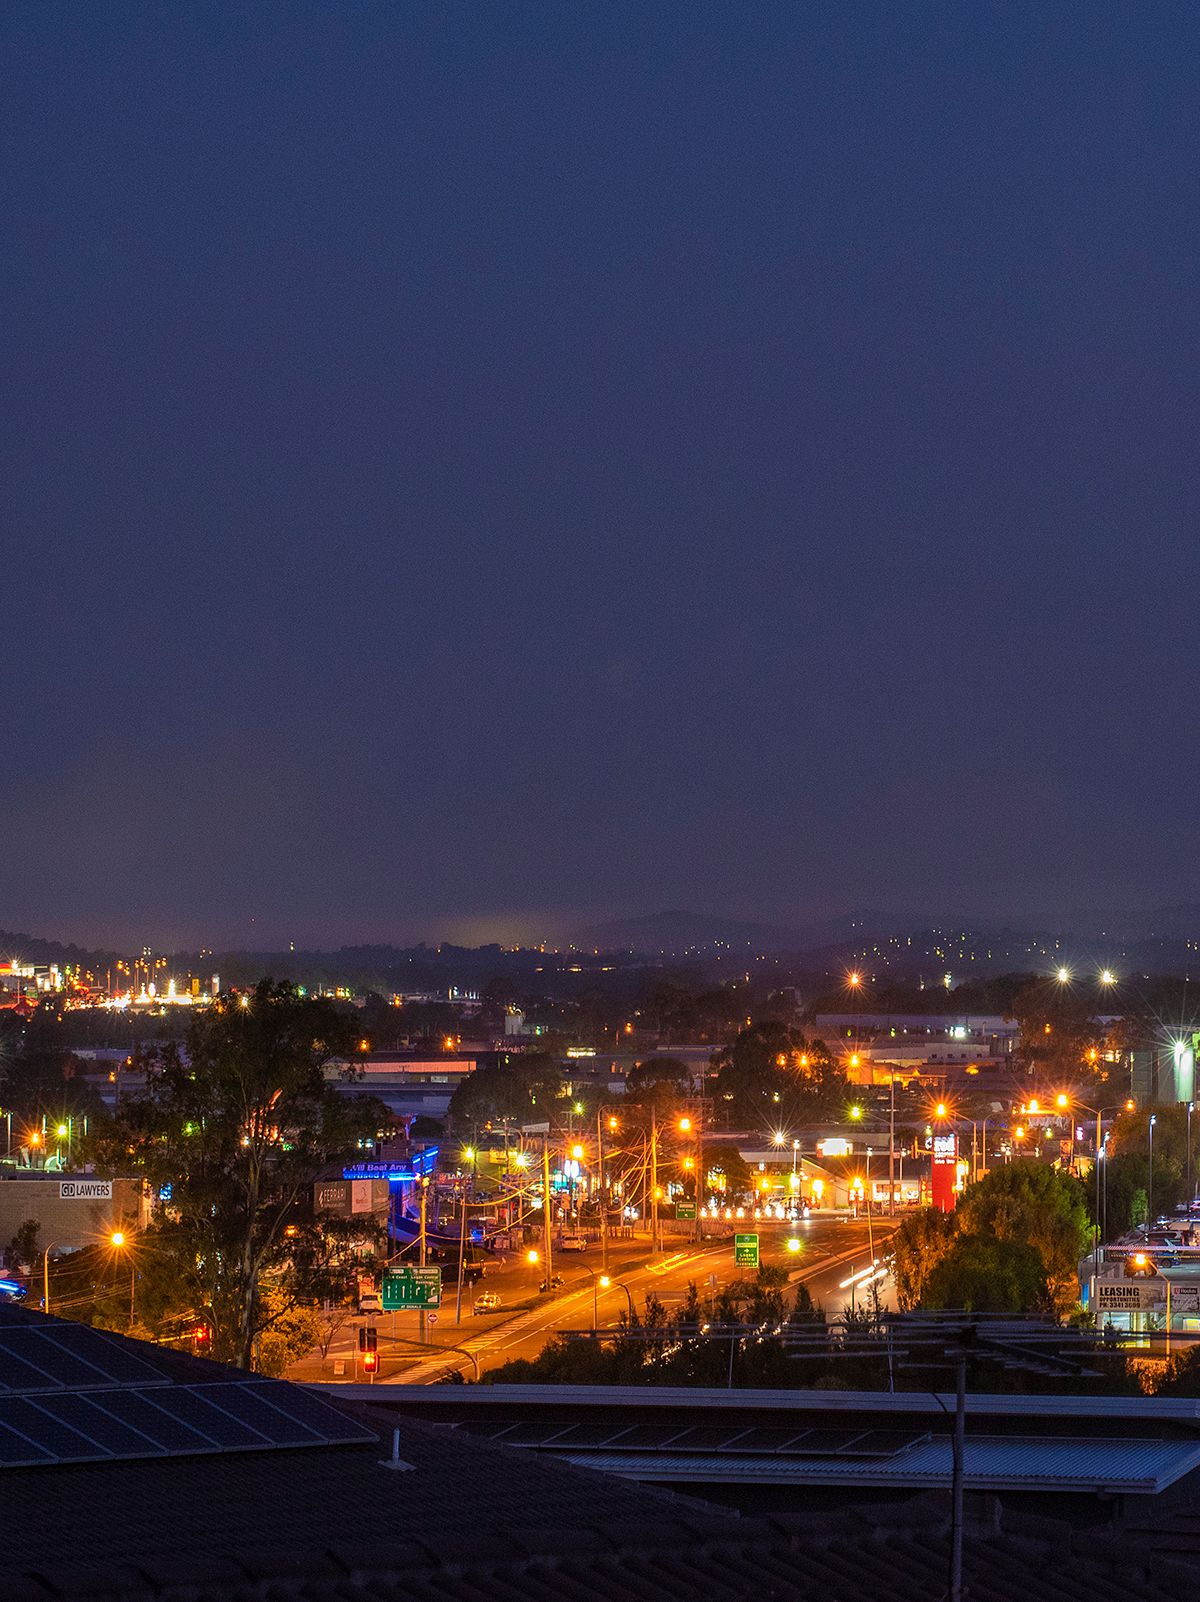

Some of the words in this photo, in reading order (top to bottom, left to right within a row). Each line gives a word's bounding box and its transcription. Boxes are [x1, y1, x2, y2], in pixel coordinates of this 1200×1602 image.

[389, 1164, 406, 1172] Any
[62, 1184, 75, 1196] GD
[76, 1184, 110, 1196] LAWYERS
[1099, 1287, 1140, 1297] LEASING
